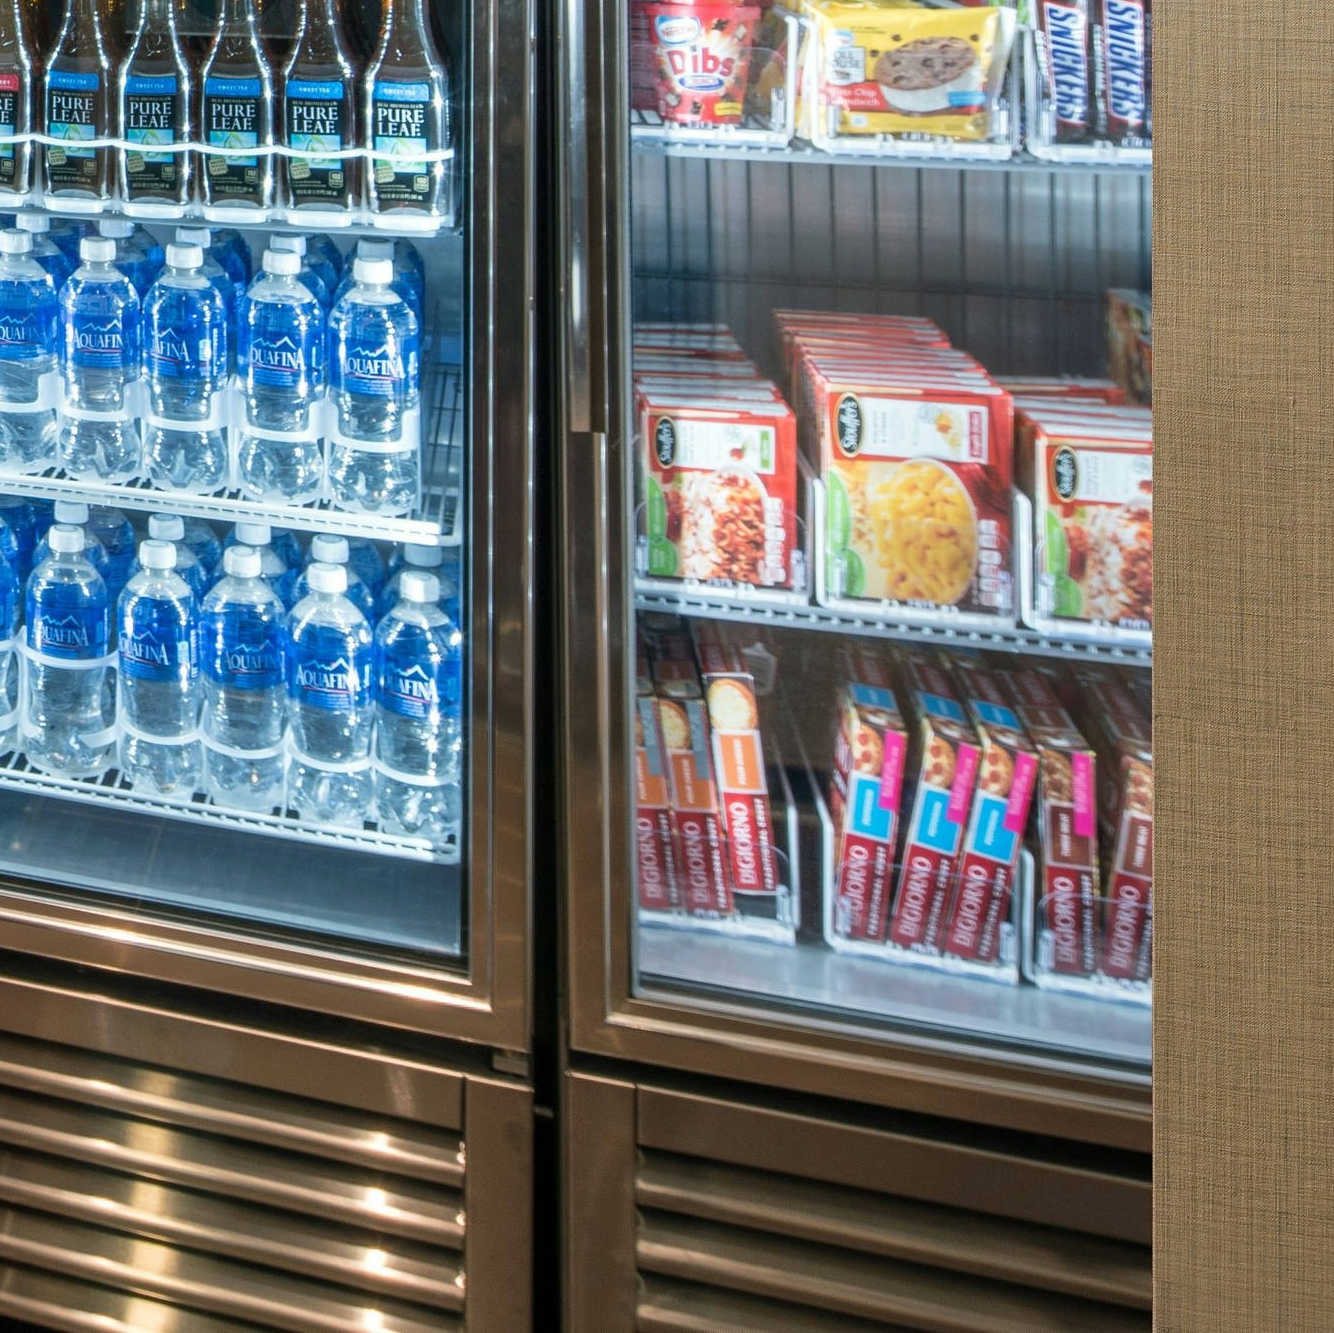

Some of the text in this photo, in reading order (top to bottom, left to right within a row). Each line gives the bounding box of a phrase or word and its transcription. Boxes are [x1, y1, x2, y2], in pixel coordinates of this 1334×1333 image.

[667, 45, 735, 77] Dibs
[1048, 7, 1086, 122] SNICKERS
[1107, 0, 1144, 122] SNICKERS
[52, 96, 94, 111] PURE
[130, 101, 172, 115] PURE
[212, 104, 256, 118] PURE
[292, 106, 339, 120] PURE
[378, 108, 425, 124] PURE
